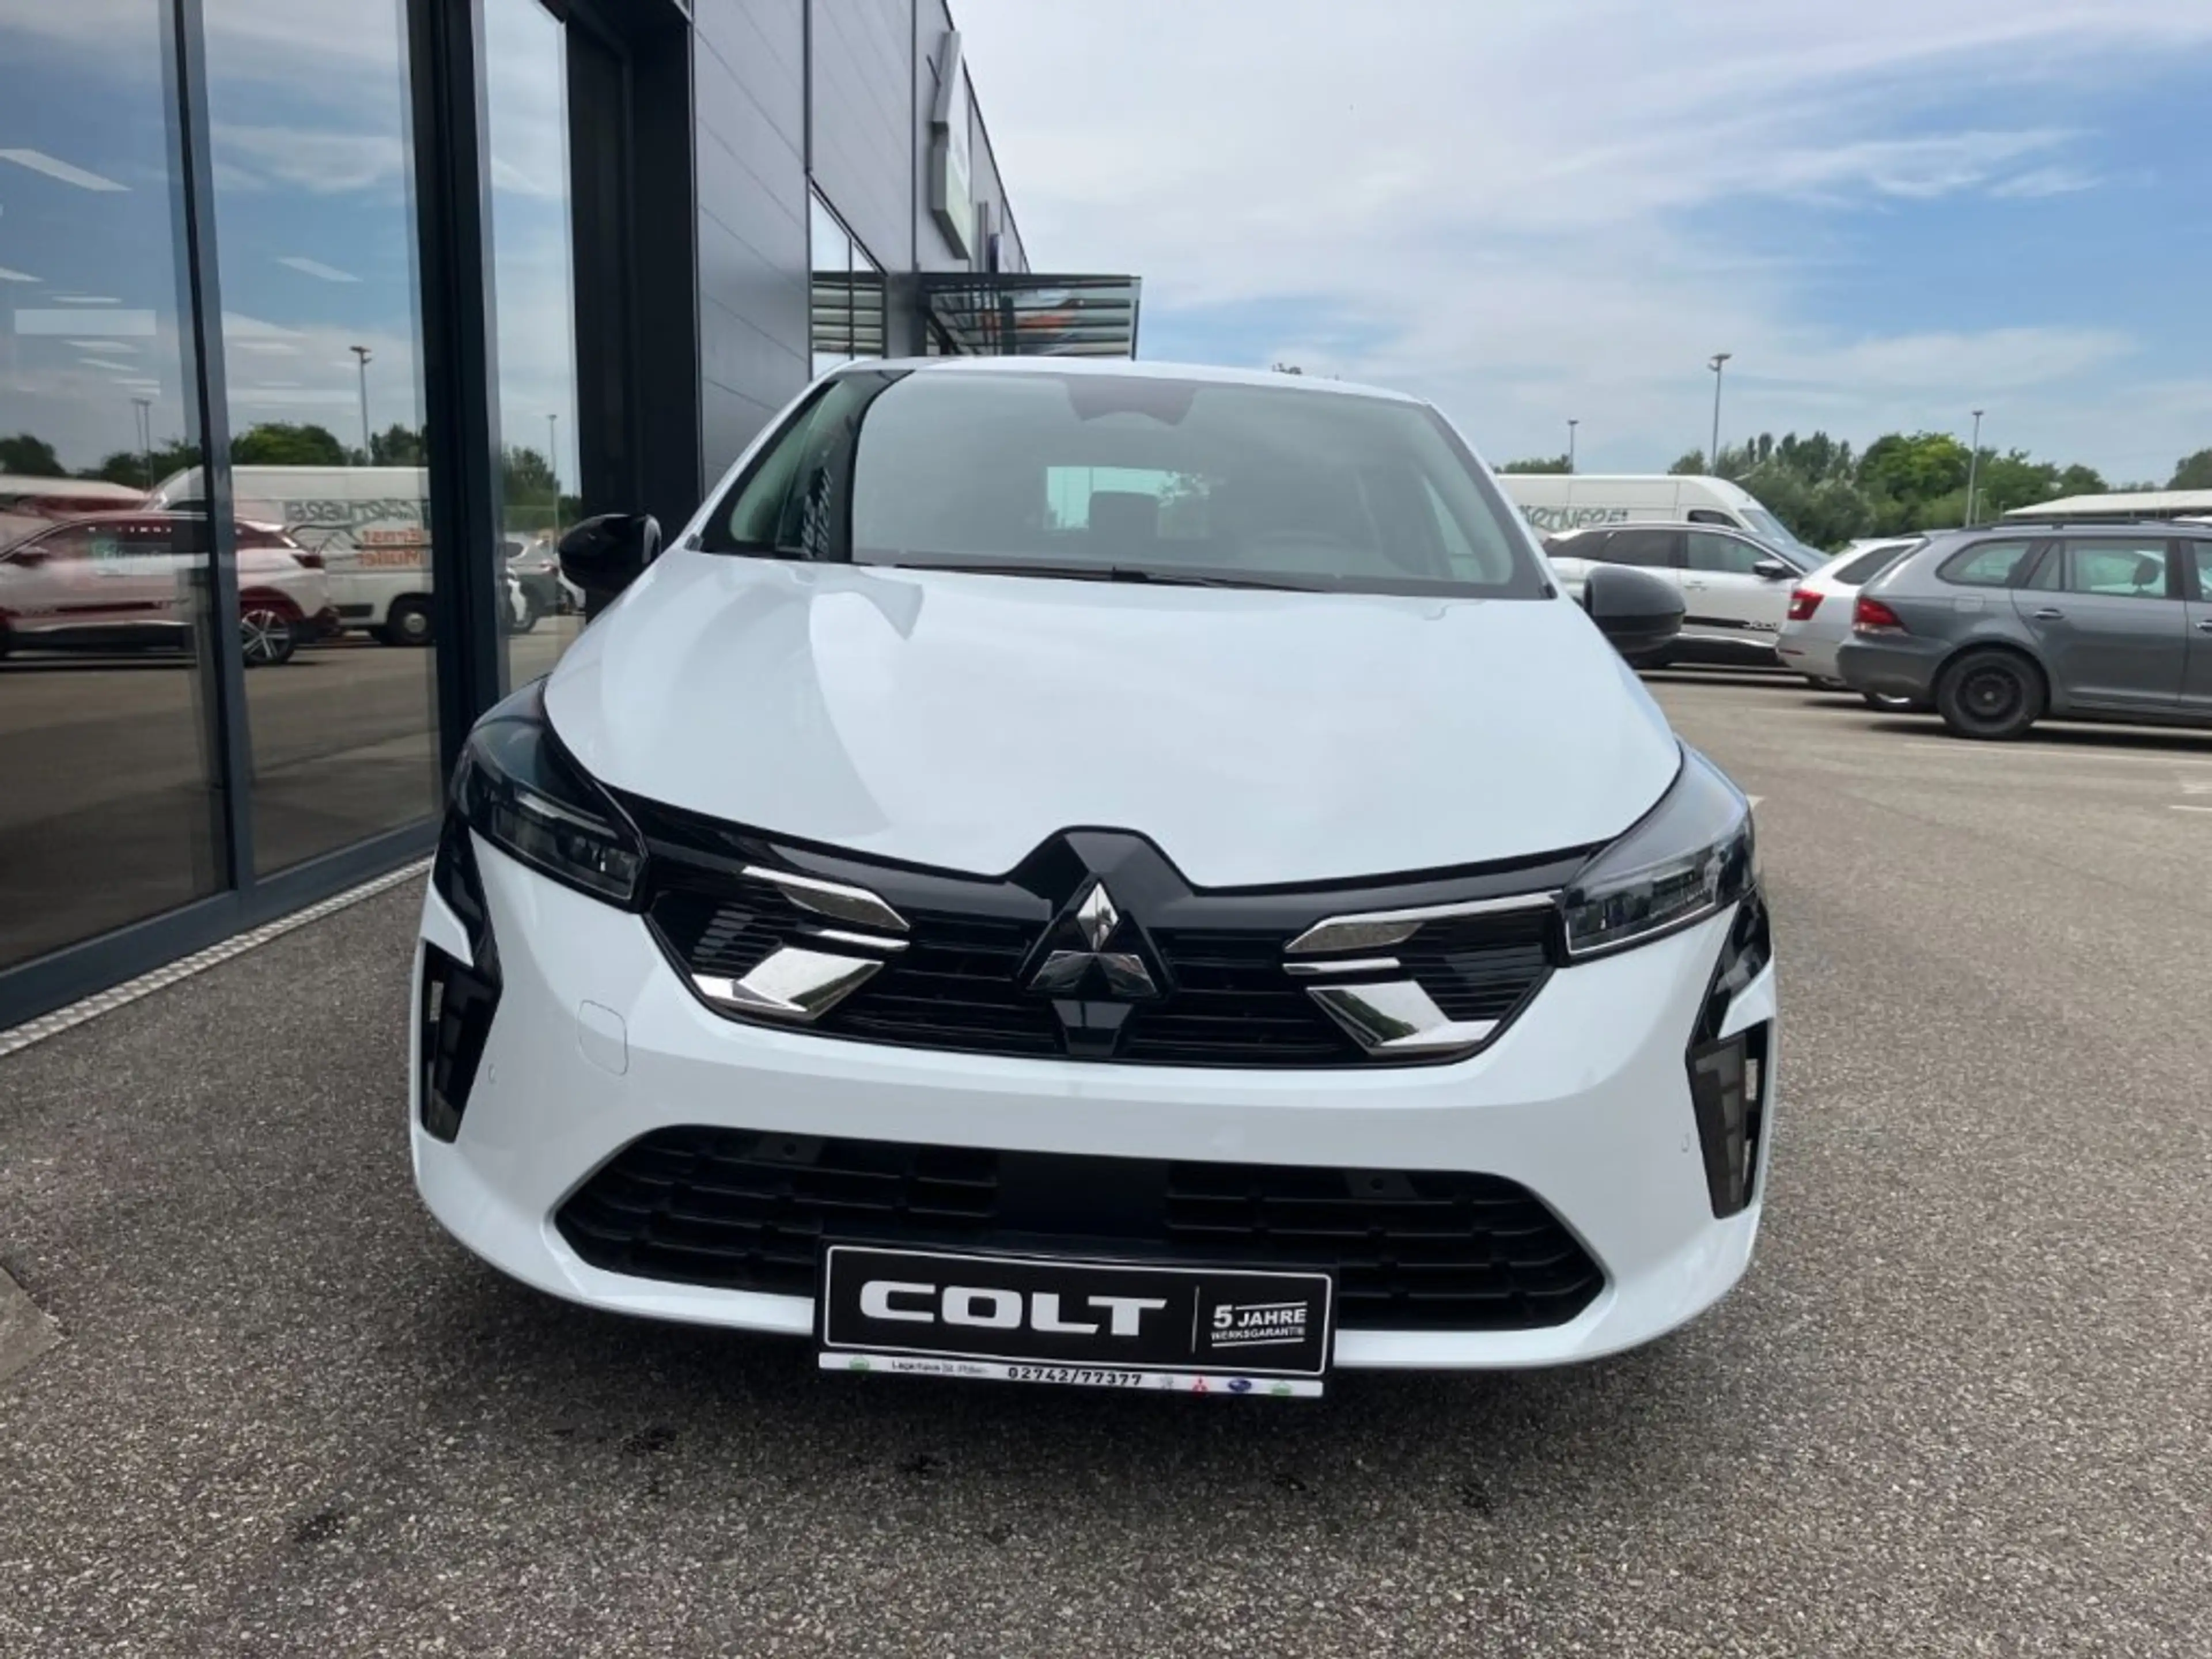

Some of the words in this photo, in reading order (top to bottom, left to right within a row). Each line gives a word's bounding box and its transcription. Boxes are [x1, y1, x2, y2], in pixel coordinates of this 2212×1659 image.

[860, 1280, 1167, 1336] COLT
[1213, 1305, 1233, 1329] 5
[1237, 1308, 1308, 1327] JAHRE
[1008, 1367, 1142, 1386] 02742/77377
